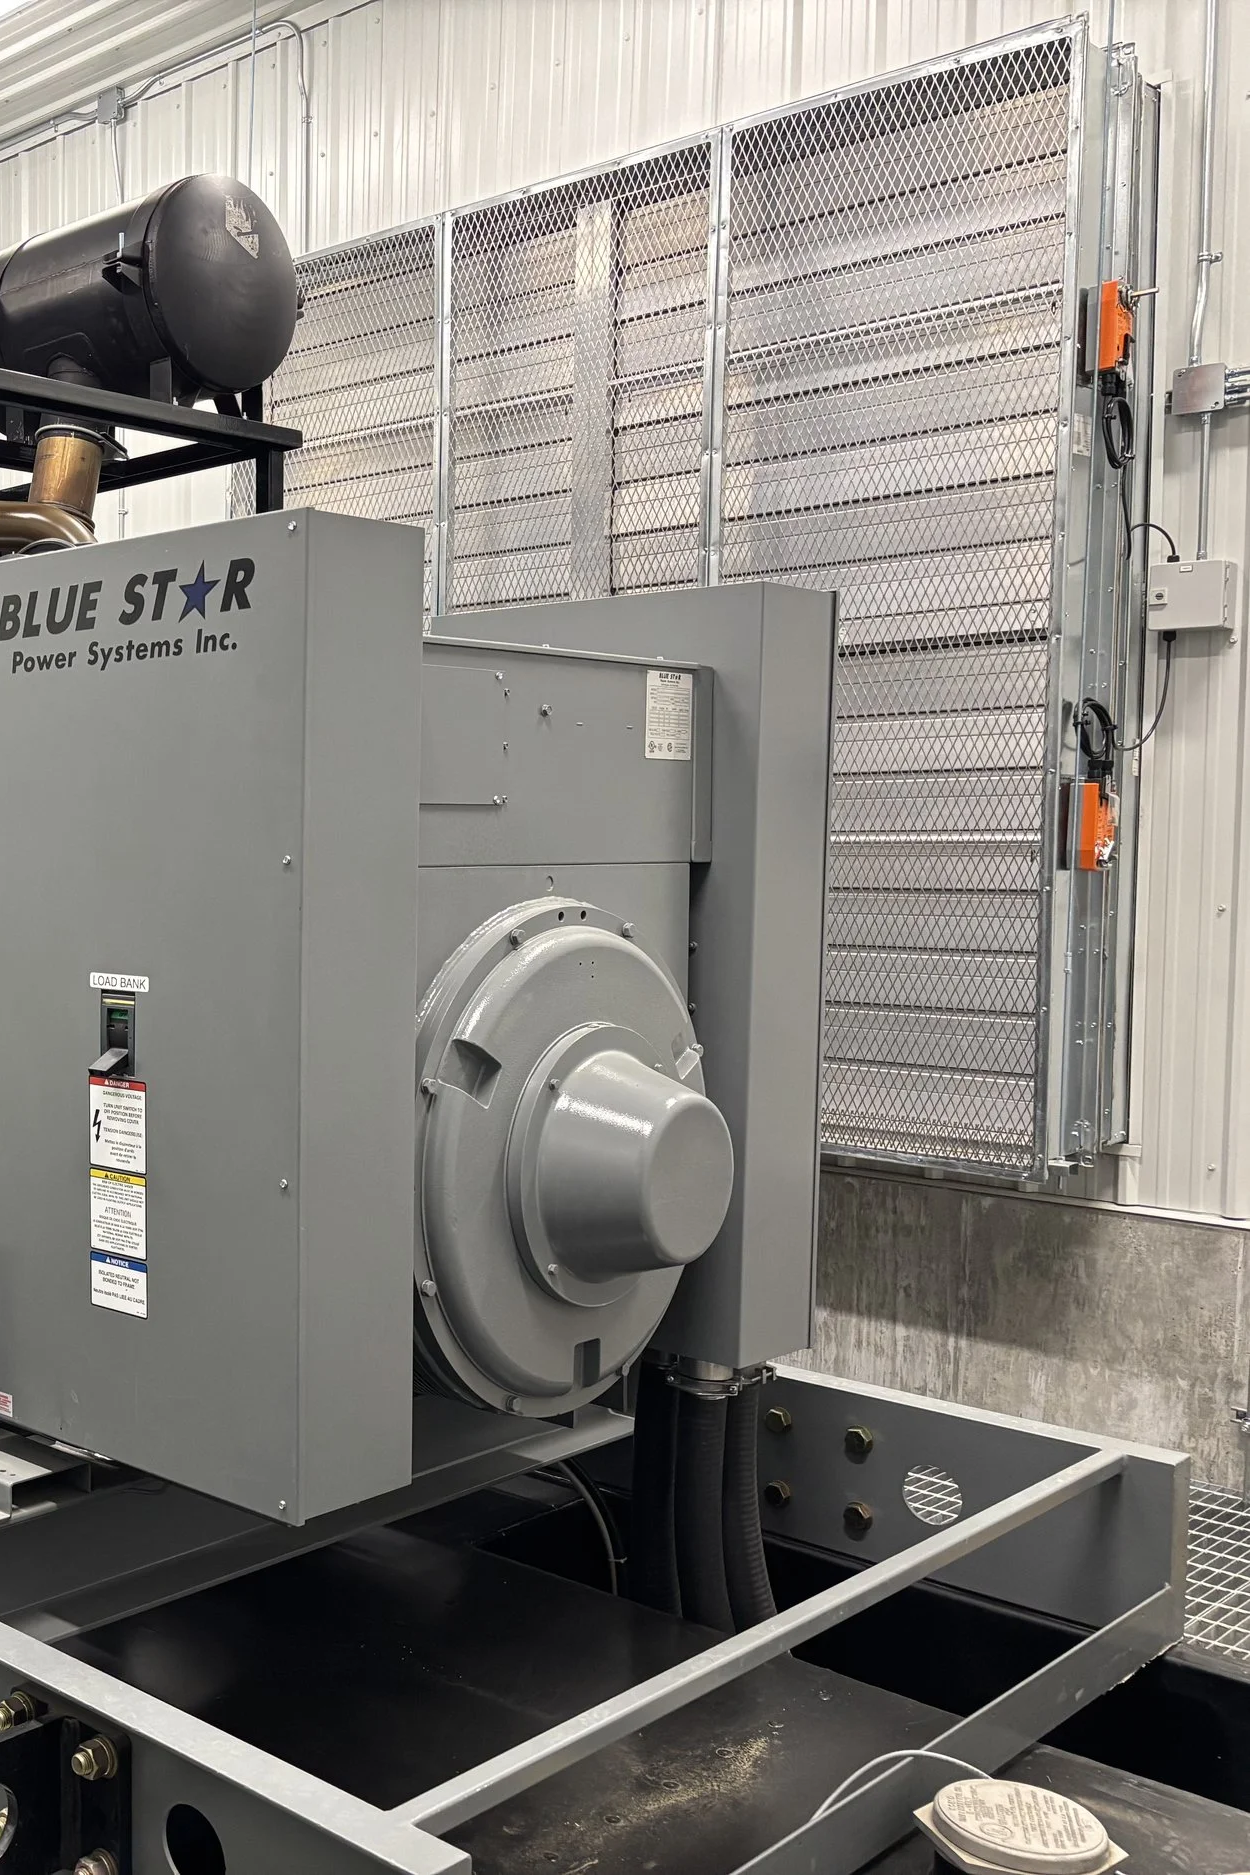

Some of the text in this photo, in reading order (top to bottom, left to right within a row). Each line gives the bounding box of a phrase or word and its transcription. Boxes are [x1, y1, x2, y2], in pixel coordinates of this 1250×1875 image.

[12, 629, 237, 674] Power Systems Inc.
[93, 975, 146, 989] LOAD BANK
[110, 1174, 130, 1183] CAUTION
[105, 1206, 131, 1218] ATTENTION
[110, 1258, 129, 1267] NOTICE
